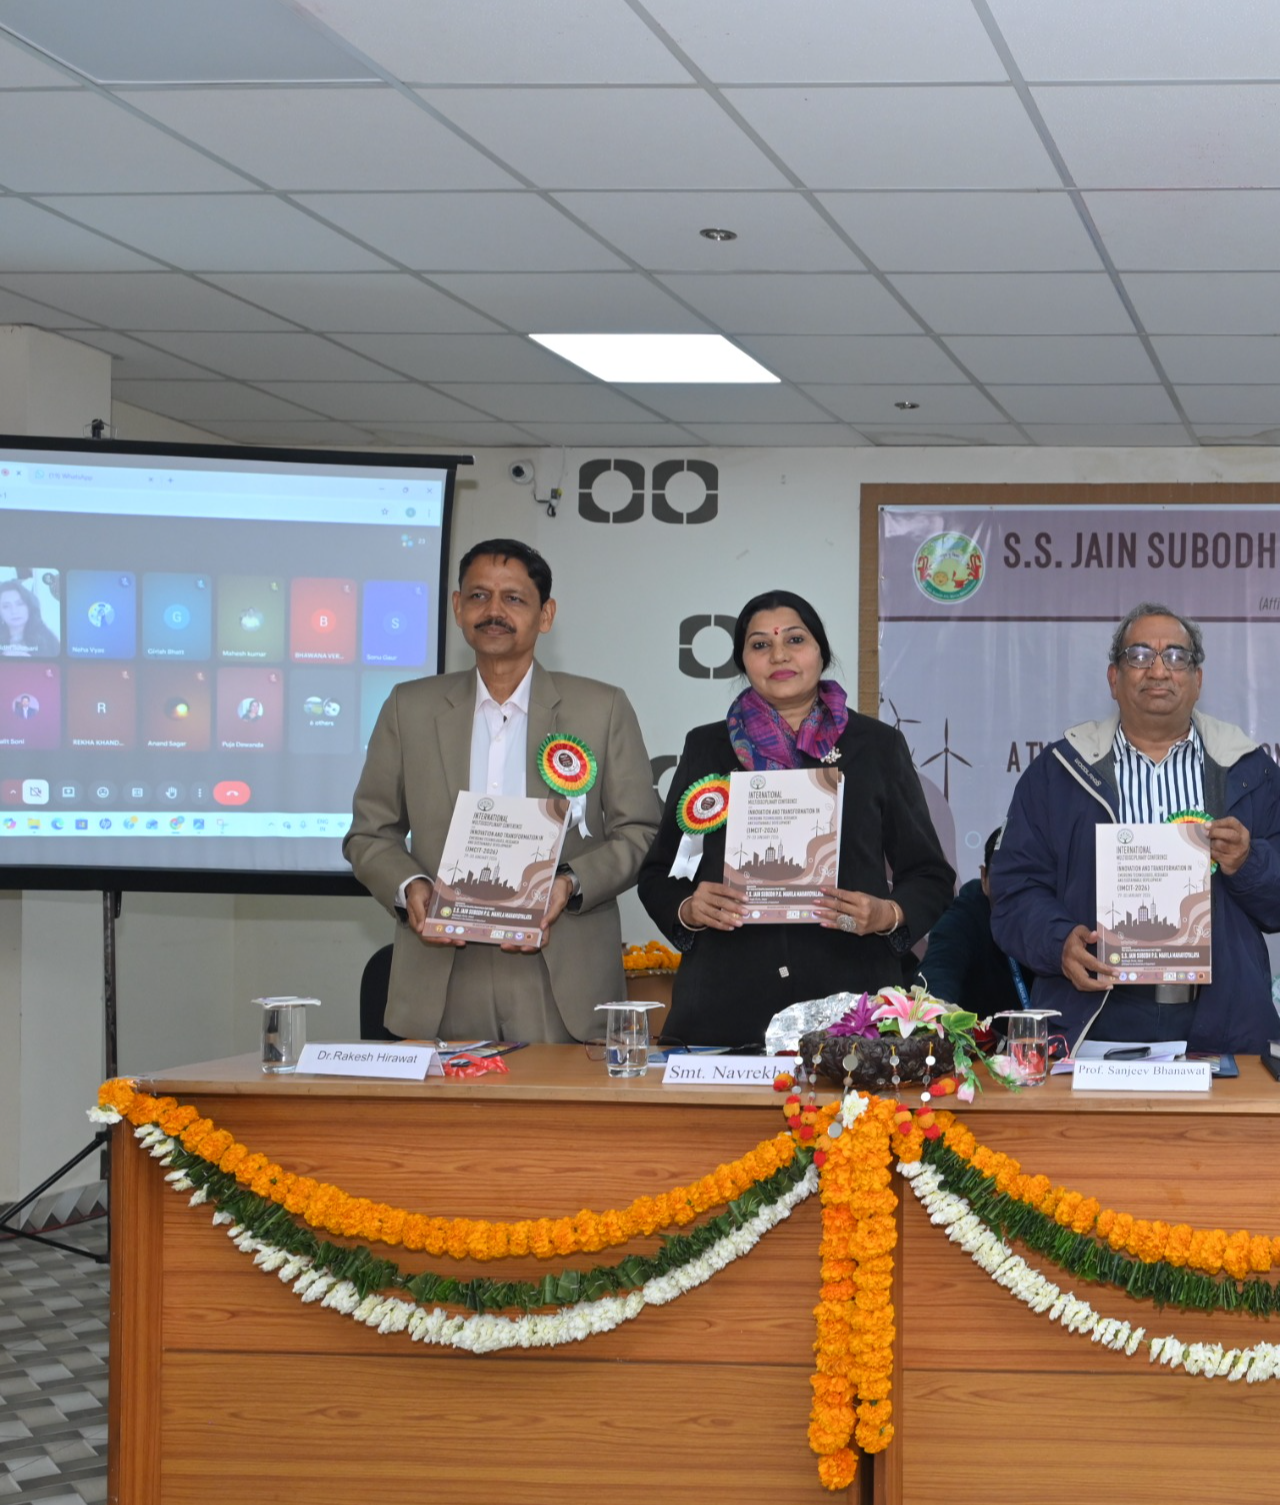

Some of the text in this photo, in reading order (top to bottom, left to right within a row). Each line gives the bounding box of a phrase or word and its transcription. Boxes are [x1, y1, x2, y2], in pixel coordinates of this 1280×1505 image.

[1004, 532, 1062, 569] S.S.
[1071, 532, 1136, 568] JAIN
[1148, 532, 1275, 569] SUBODH
[172, 612, 181, 623] G
[320, 616, 328, 627] B
[392, 618, 399, 629] S
[98, 702, 106, 713] R
[1007, 742, 1020, 772] A
[1117, 846, 1151, 854] INTERNATIONAL
[317, 1050, 417, 1064] Dr.Rakesh Hirawat
[670, 1065, 705, 1079] Smt.
[1079, 1065, 1205, 1078] Prof. Sanjeev Bhanawat
